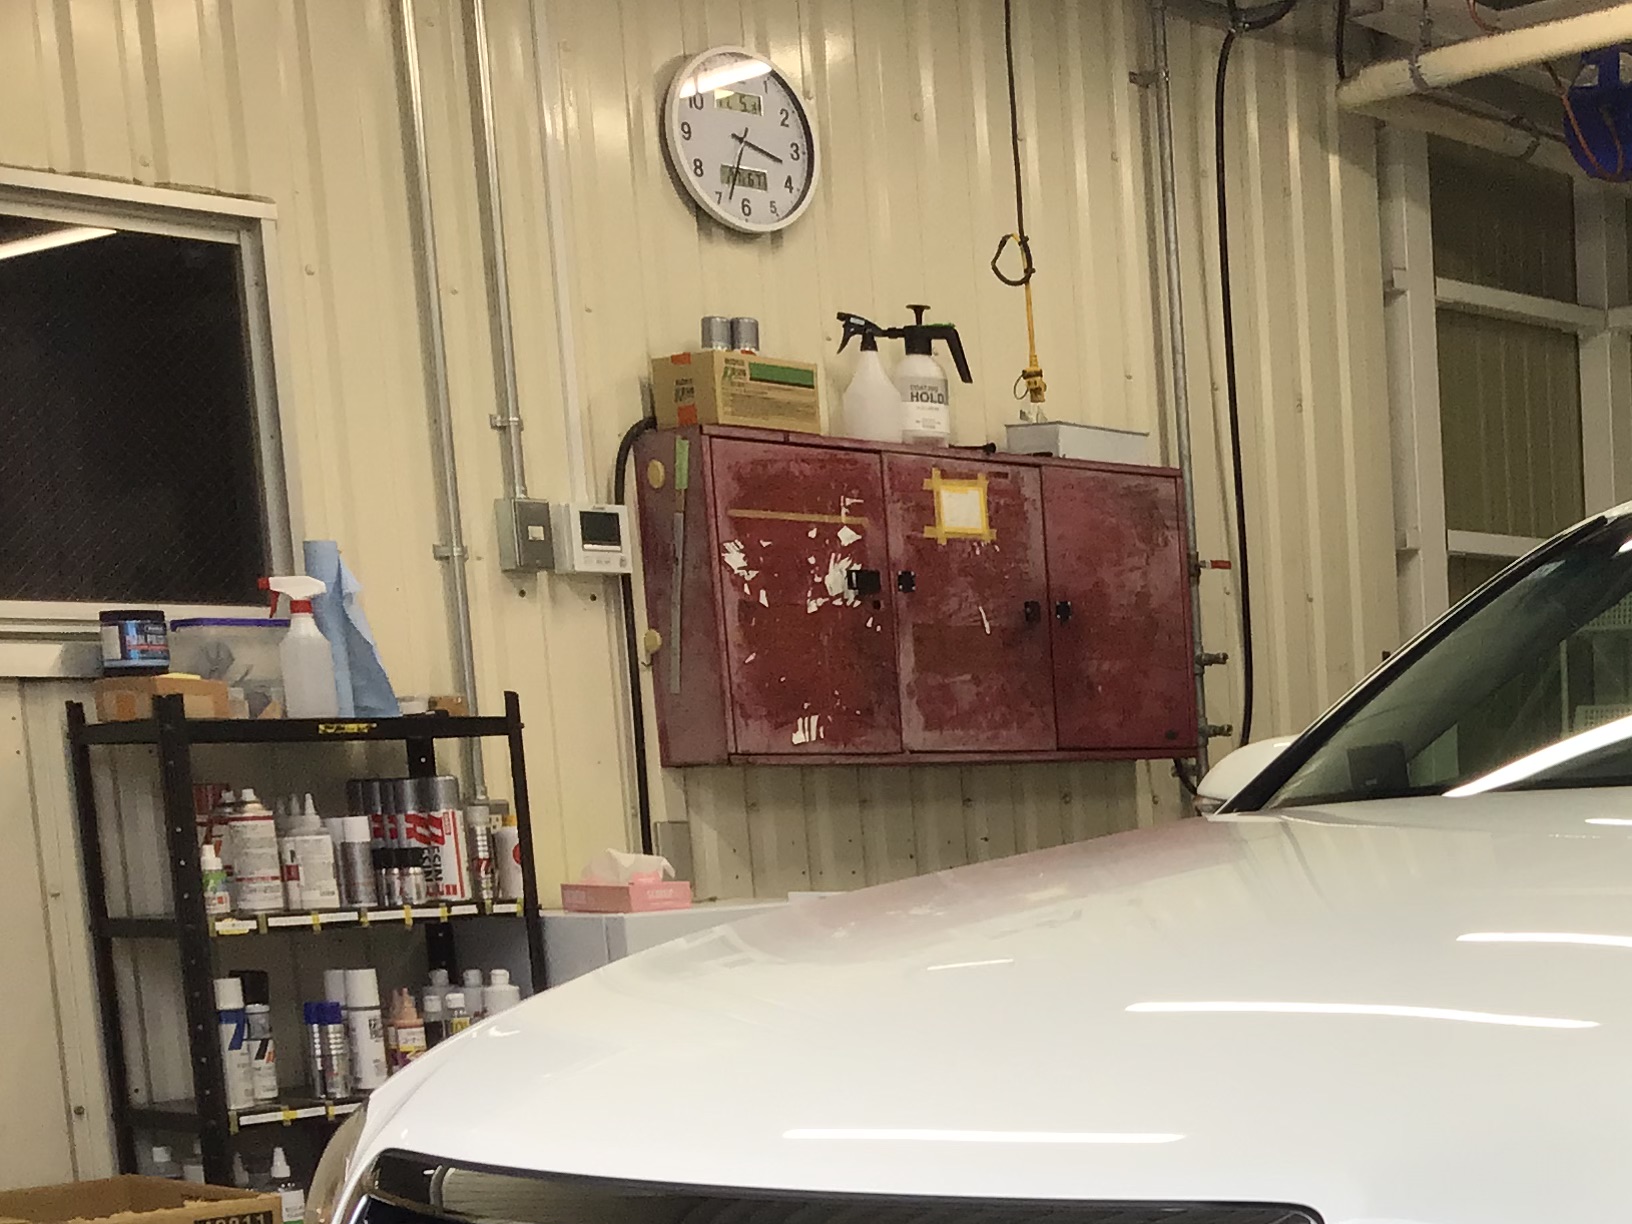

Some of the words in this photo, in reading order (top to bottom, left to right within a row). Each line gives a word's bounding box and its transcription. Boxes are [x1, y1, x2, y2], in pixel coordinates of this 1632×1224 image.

[688, 91, 704, 111] 10
[779, 108, 790, 128] 2
[680, 121, 691, 141] 9
[790, 142, 800, 161] 3
[693, 158, 704, 178] 8
[784, 175, 794, 194] 4
[715, 191, 723, 205] 7
[741, 197, 752, 217] 6
[769, 200, 778, 215] 5
[910, 391, 945, 405] HOLD
